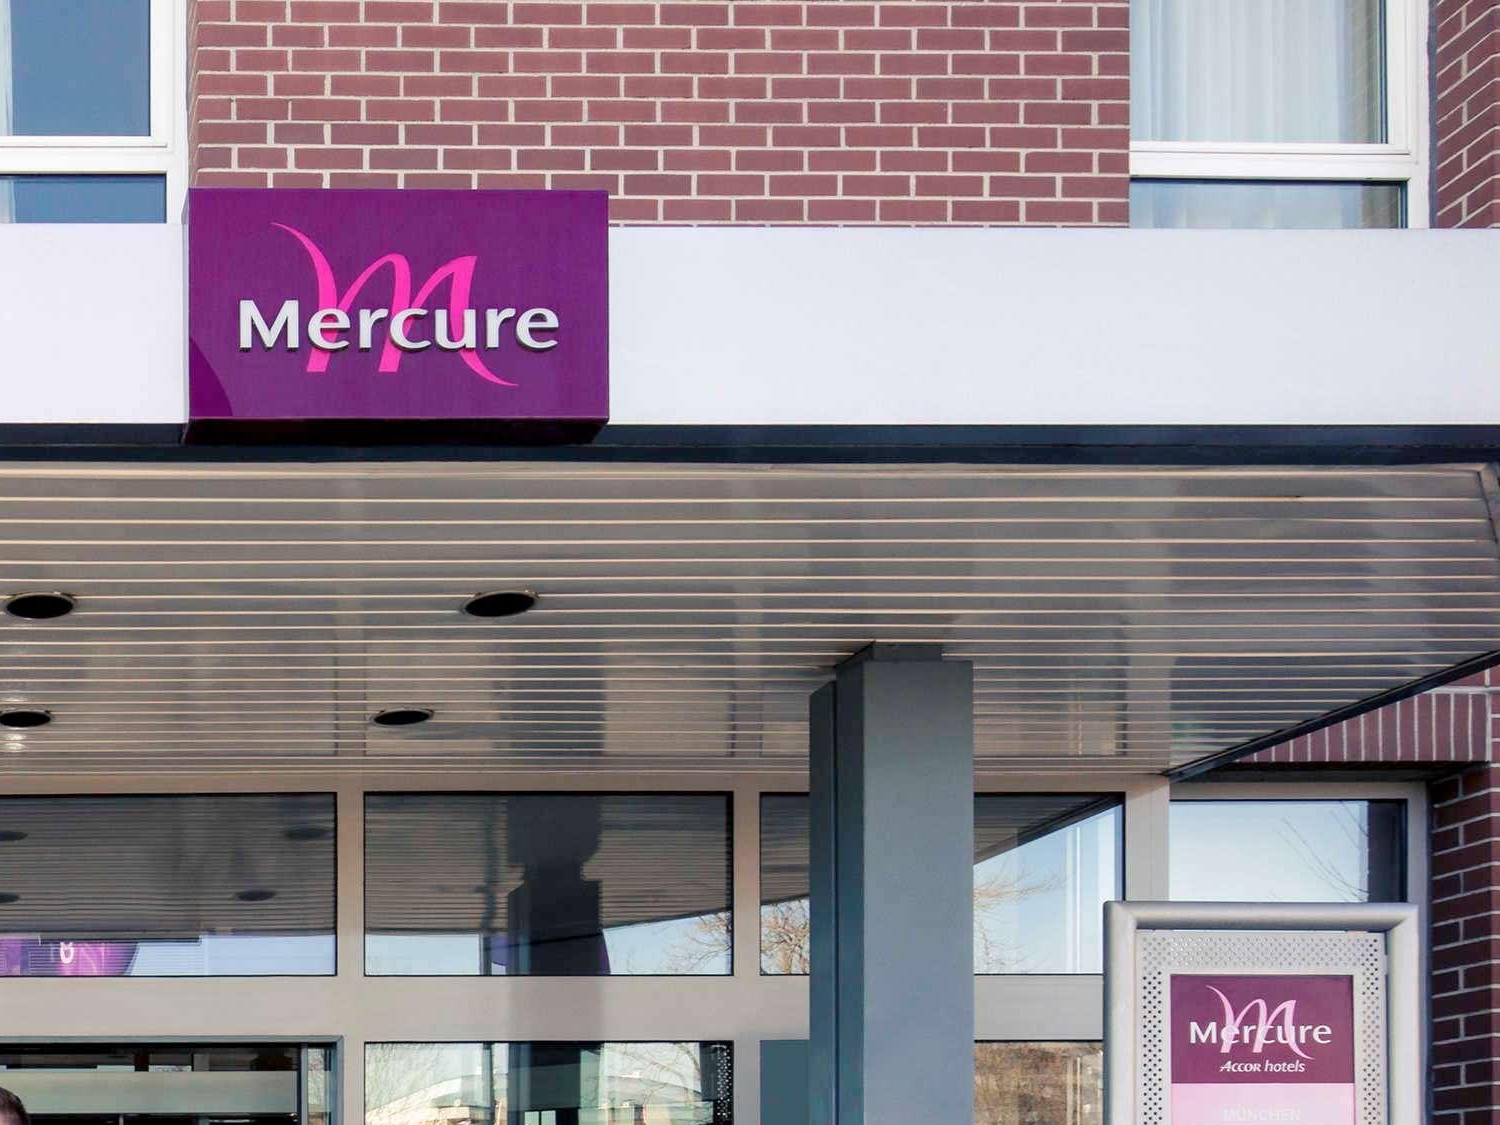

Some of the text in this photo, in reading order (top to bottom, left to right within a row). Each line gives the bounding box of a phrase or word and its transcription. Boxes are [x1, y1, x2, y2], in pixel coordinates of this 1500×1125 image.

[238, 299, 560, 351] Mercure
[1189, 1021, 1332, 1045] Mercure
[1264, 1059, 1306, 1073] hotels
